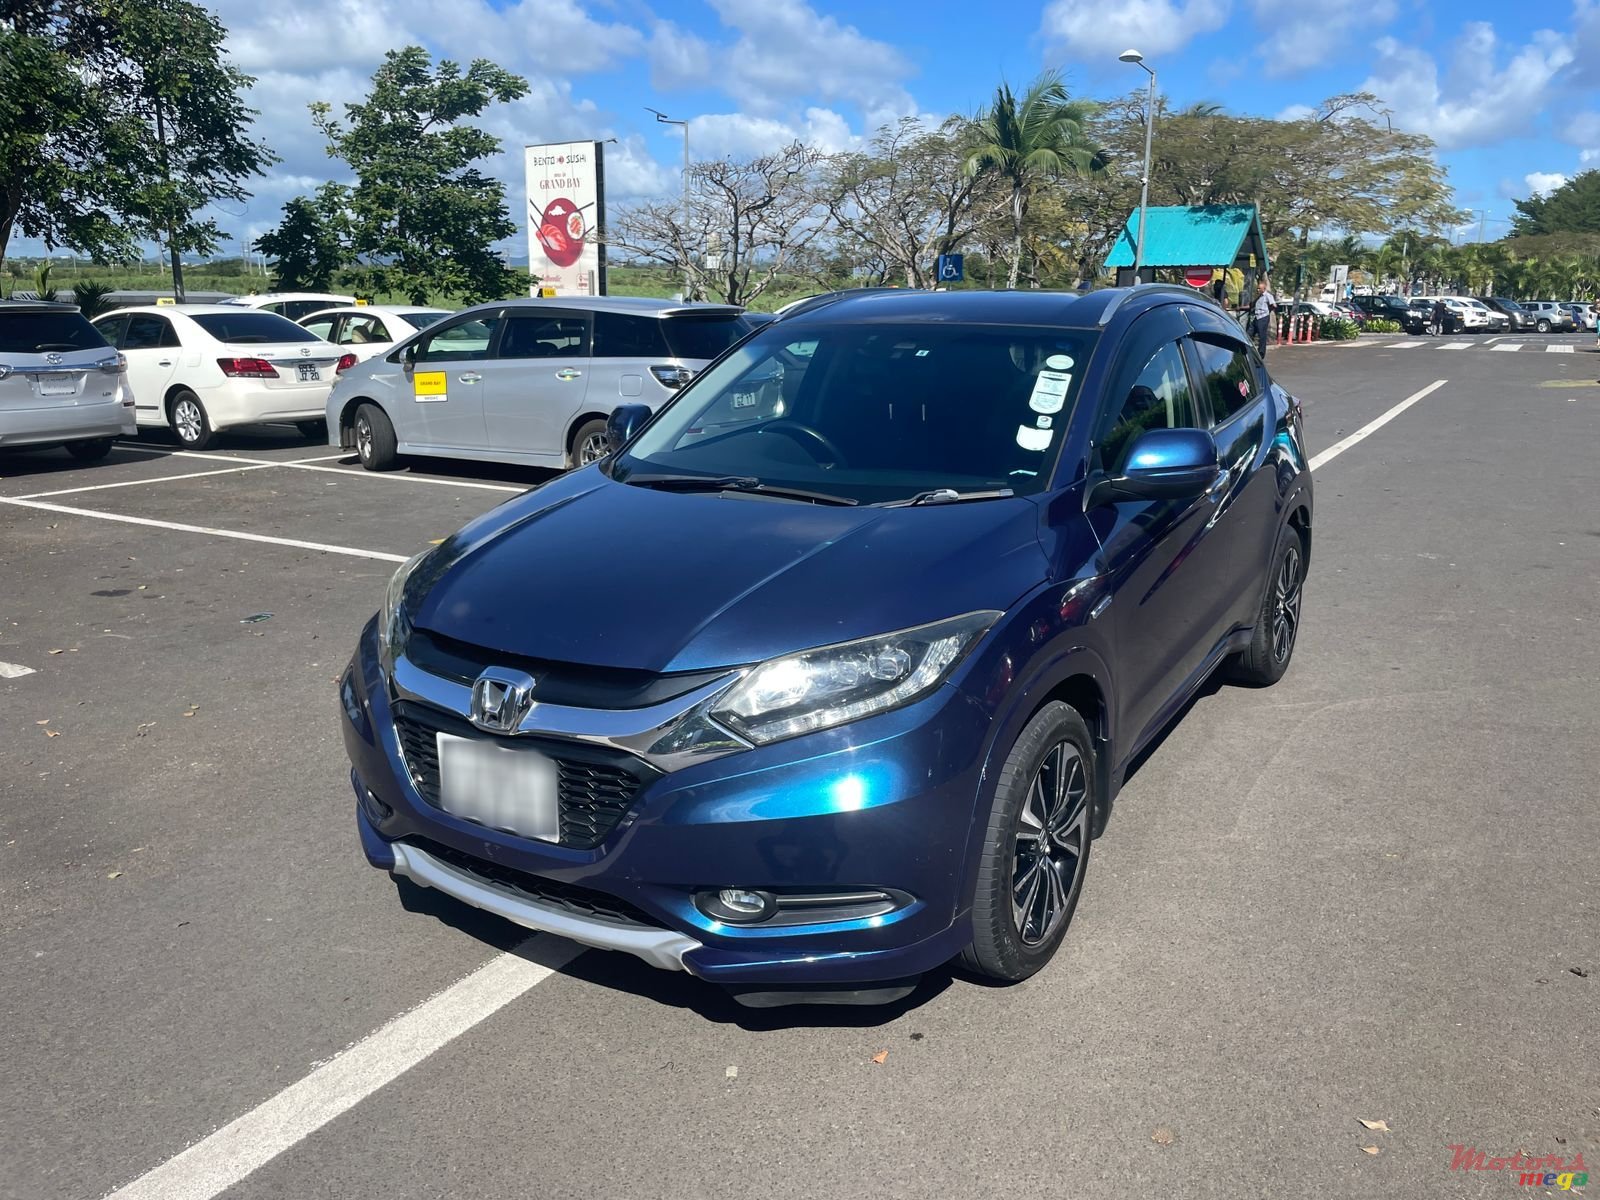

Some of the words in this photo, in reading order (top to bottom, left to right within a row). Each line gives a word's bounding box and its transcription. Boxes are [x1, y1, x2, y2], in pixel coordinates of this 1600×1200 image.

[533, 156, 555, 166] BENTO
[566, 154, 586, 164] SUSHI
[539, 178, 565, 190] GRAND
[566, 177, 580, 189] BAY
[310, 371, 320, 381] 20
